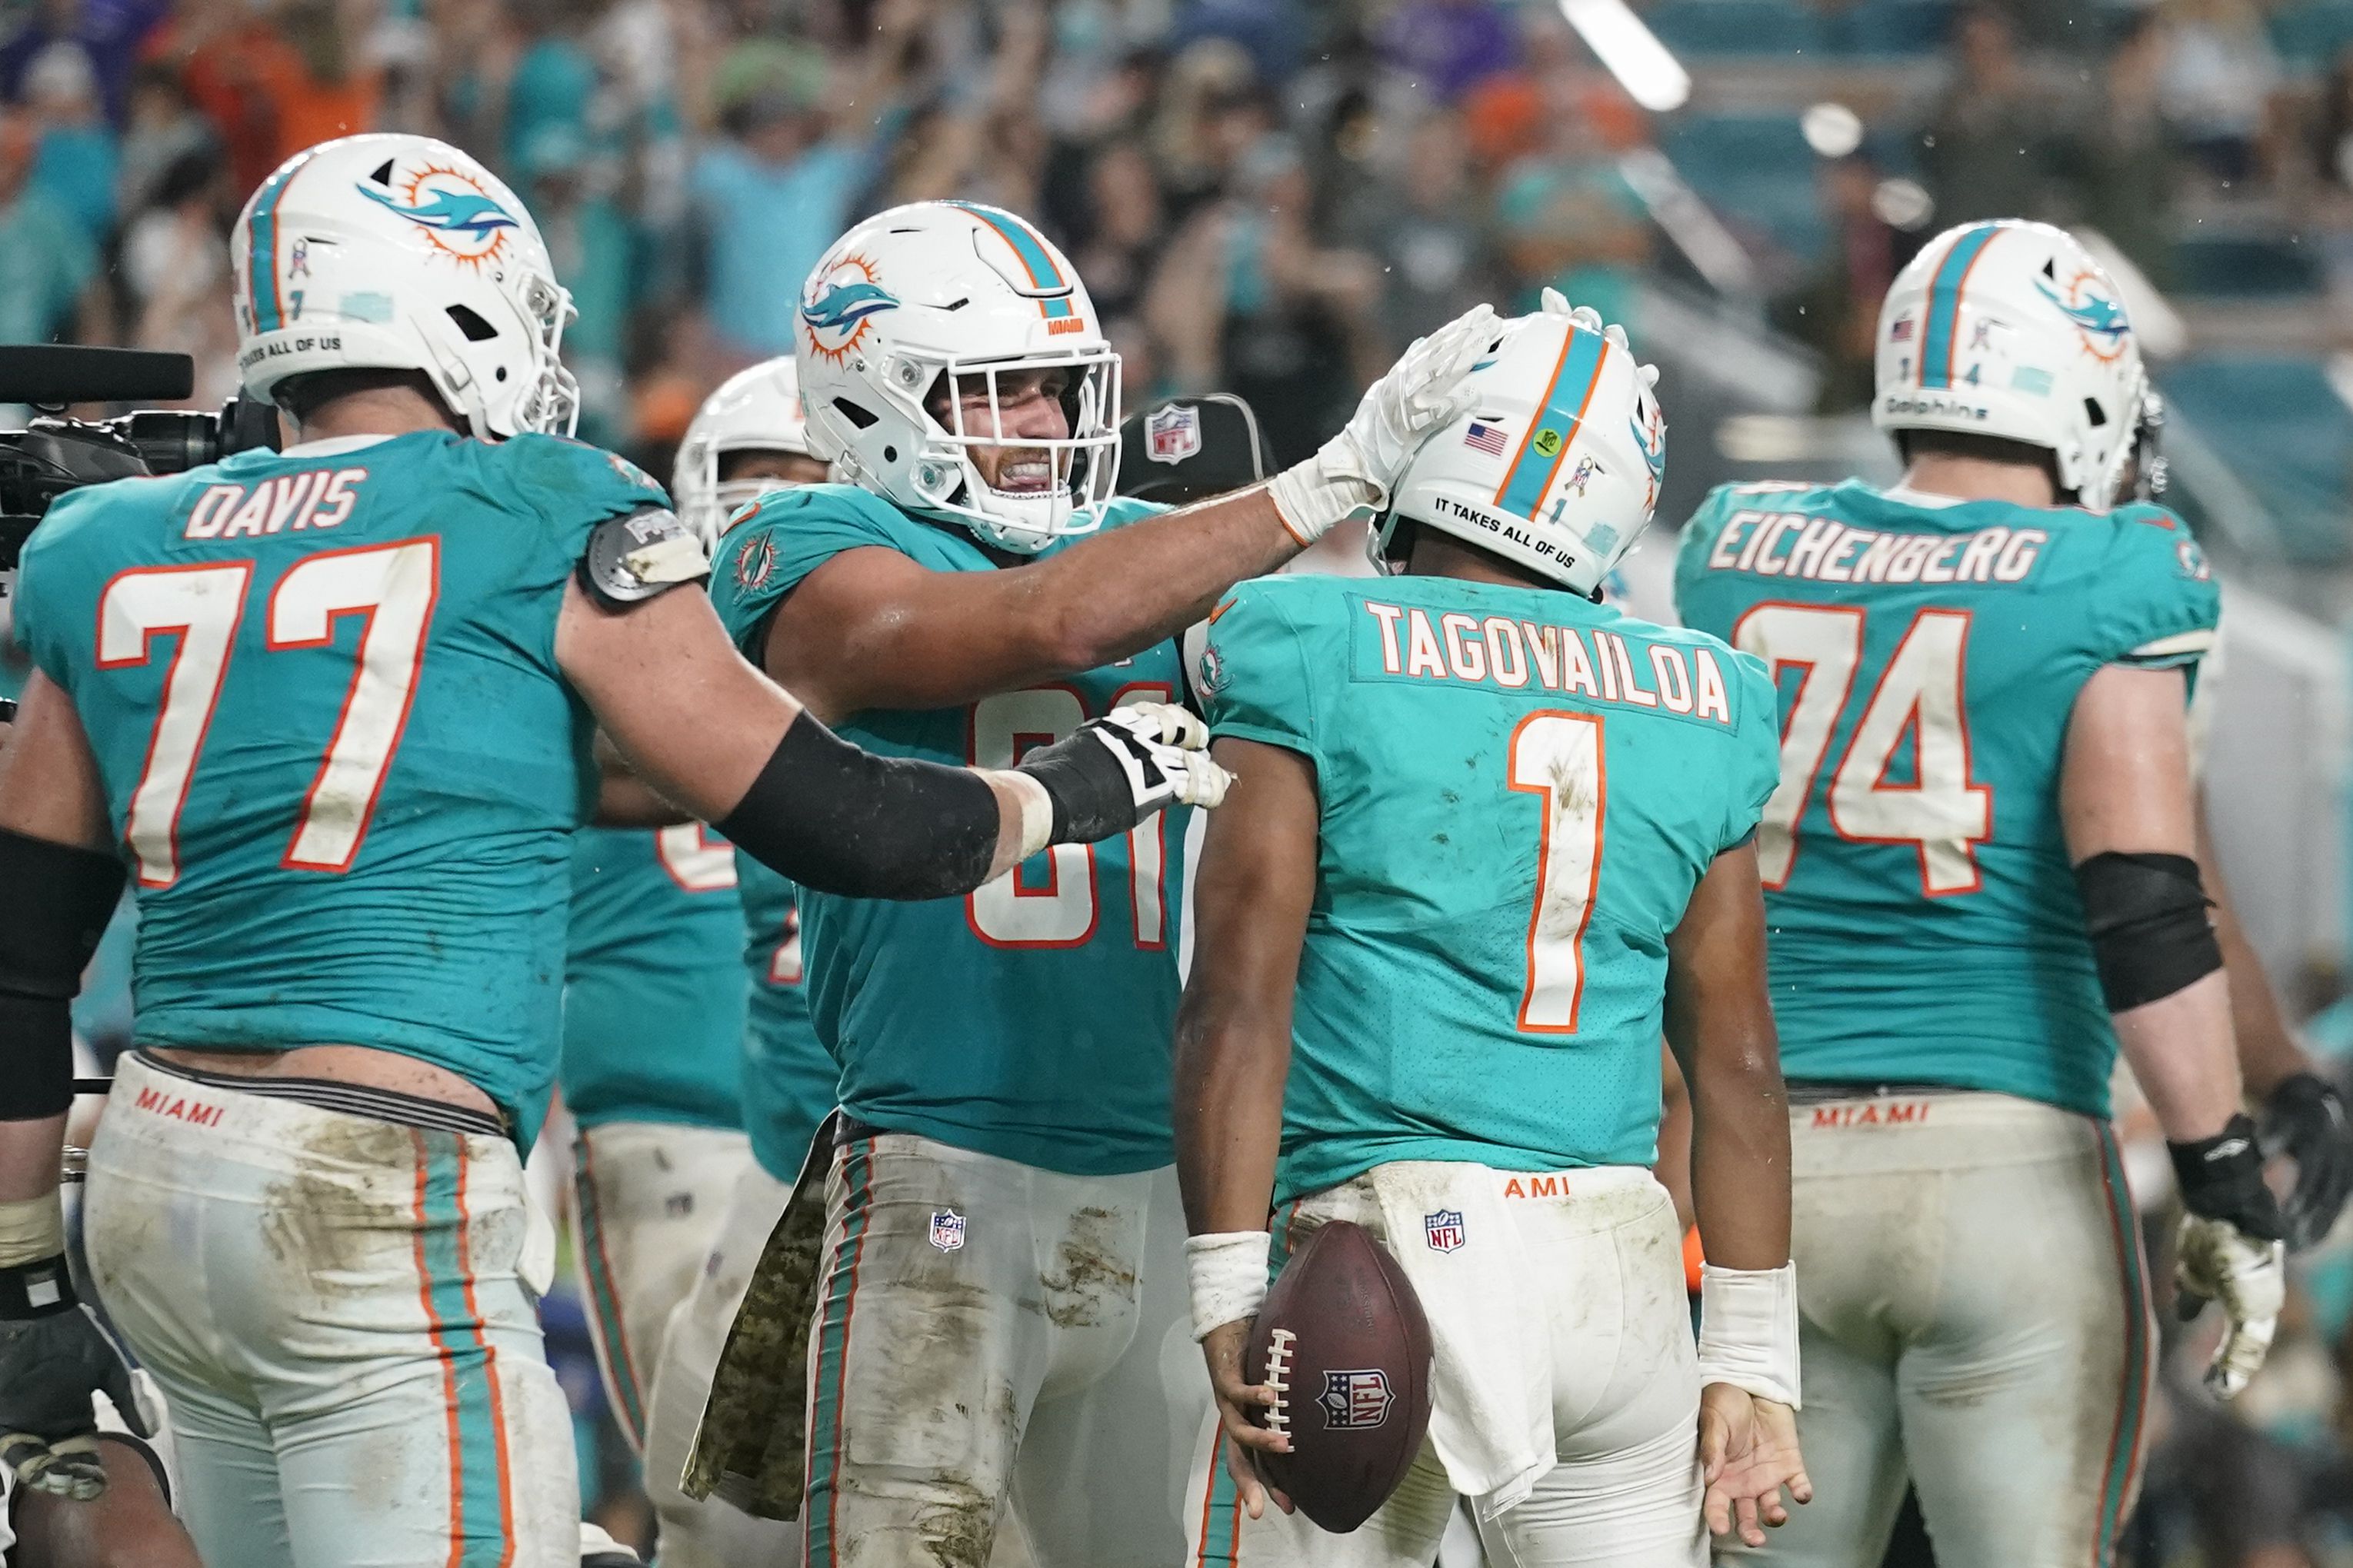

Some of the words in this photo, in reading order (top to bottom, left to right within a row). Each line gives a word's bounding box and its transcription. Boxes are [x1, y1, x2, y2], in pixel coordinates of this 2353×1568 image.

[269, 340, 292, 356] ALL
[295, 338, 315, 352] OF
[320, 338, 342, 351] US
[185, 467, 368, 540] DAVIS
[1549, 498, 1568, 525] 1
[1435, 498, 1449, 512] IT
[1453, 503, 1501, 532] TAKES
[1503, 526, 1531, 548] ALL
[1535, 540, 1555, 556] OF
[1555, 551, 1575, 568] US
[1708, 510, 2048, 583] EICHENBERG
[1365, 601, 1731, 724] TAGOVAILOA
[95, 534, 441, 889] 77
[1731, 600, 1993, 897] 74
[1507, 708, 1606, 1034] 1
[135, 1087, 224, 1127] MIAMI
[1811, 1102, 1930, 1130] MIAMI
[1505, 1177, 1569, 1199] AMI
[1430, 1227, 1462, 1249] NFL
[1352, 1376, 1385, 1423] NFL
